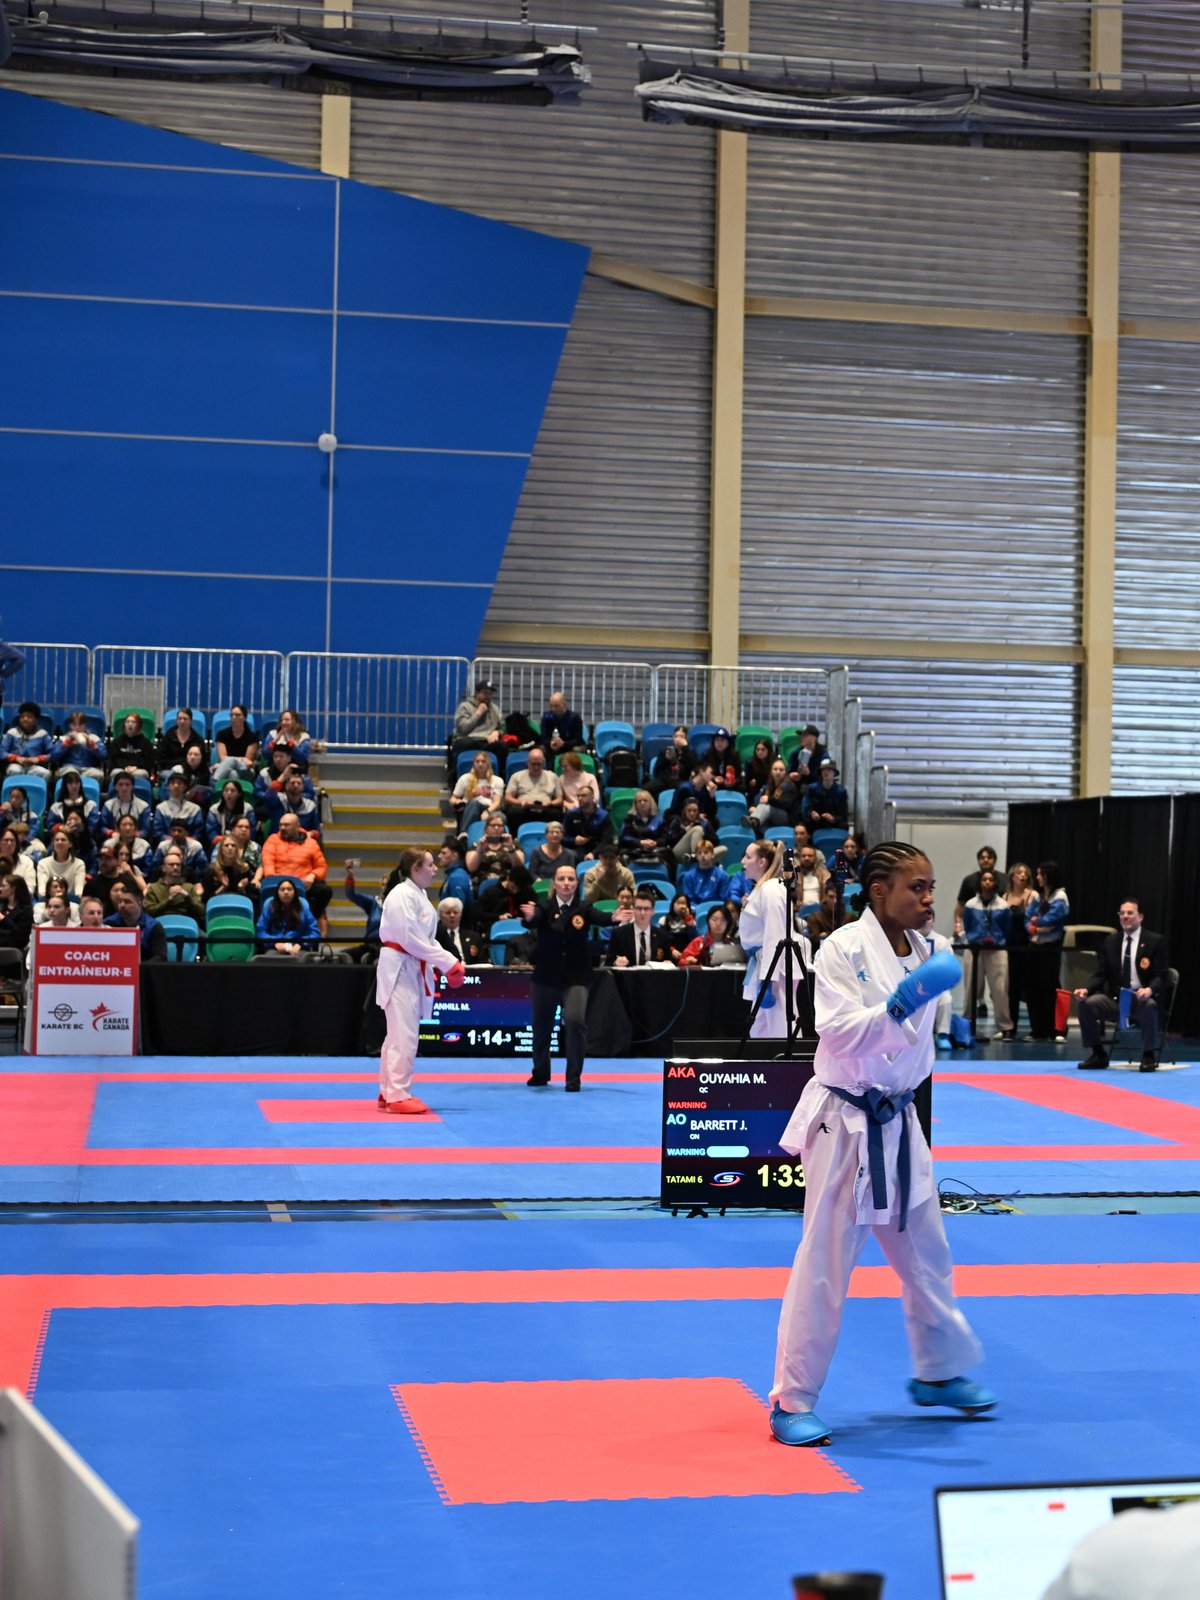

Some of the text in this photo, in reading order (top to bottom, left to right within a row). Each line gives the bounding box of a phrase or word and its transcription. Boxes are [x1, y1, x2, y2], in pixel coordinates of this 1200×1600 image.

[64, 951, 110, 961] COACH
[668, 1067, 696, 1078] AKA
[699, 1073, 767, 1084] OUYAHIA M.
[666, 1113, 687, 1125] AO
[690, 1120, 748, 1131] BARRETT J.
[667, 1148, 706, 1156] WARNING
